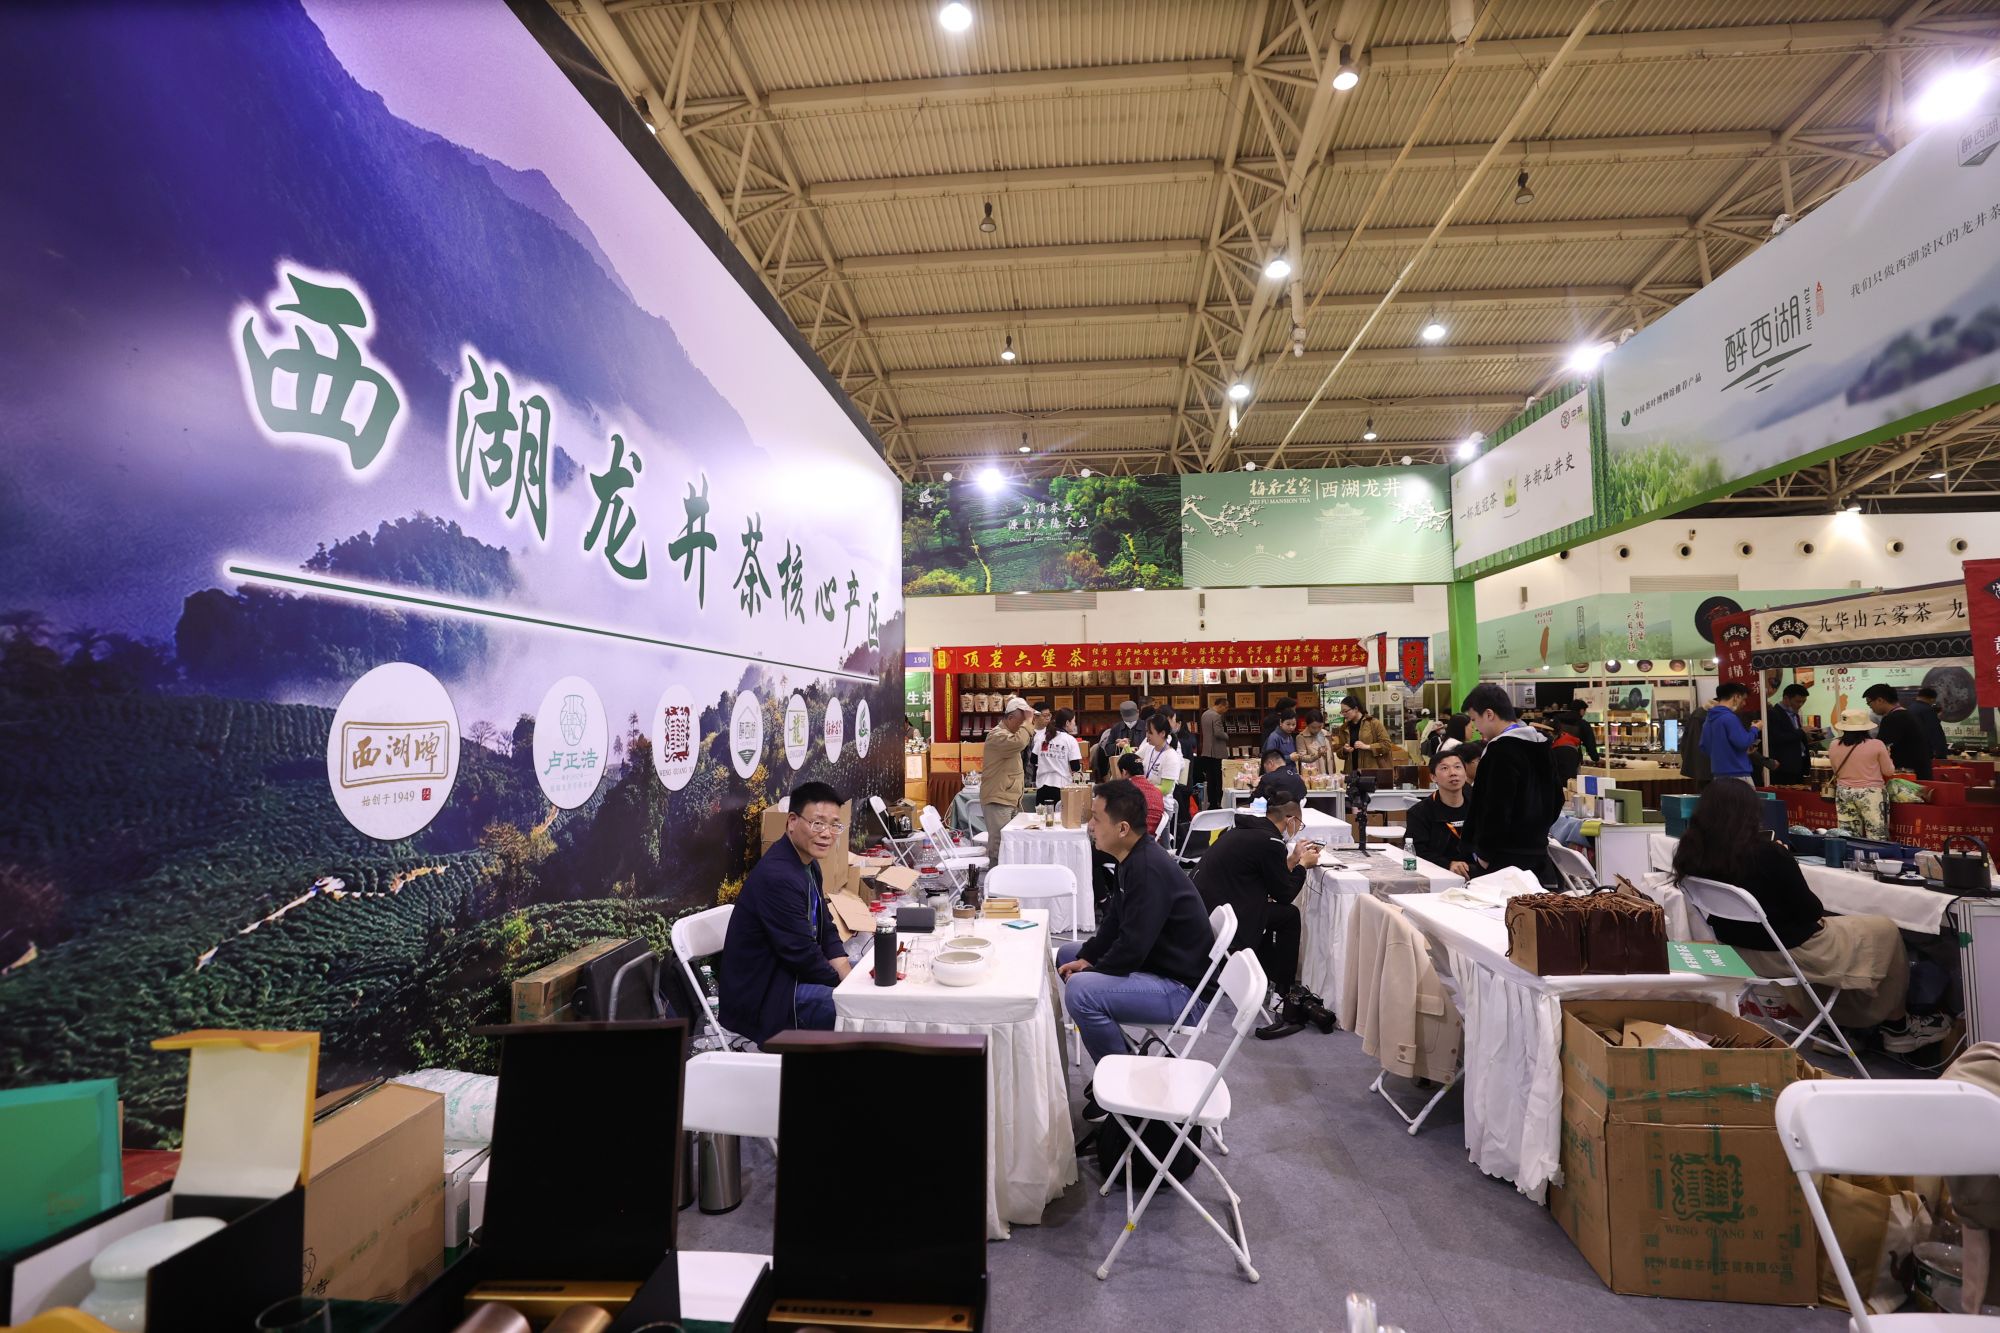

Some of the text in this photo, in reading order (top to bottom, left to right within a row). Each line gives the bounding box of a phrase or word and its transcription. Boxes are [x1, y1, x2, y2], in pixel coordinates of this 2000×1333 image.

[1724, 295, 1801, 373] 醉西湖
[242, 272, 879, 649] 西湖龙井茶核心产区
[1523, 451, 1575, 492] 半部龙井史
[1321, 478, 1401, 499] 西湖龙井
[1818, 601, 1932, 634] 九华山云雾茶
[1946, 598, 1966, 621] 九
[913, 656, 927, 664] 190
[963, 647, 1087, 669] 顶茗六堡茶
[352, 731, 440, 773] 西湖牌
[544, 748, 598, 775] 卢正浩
[1665, 1224, 1699, 1237] WENG
[1752, 1230, 1764, 1240] XI
